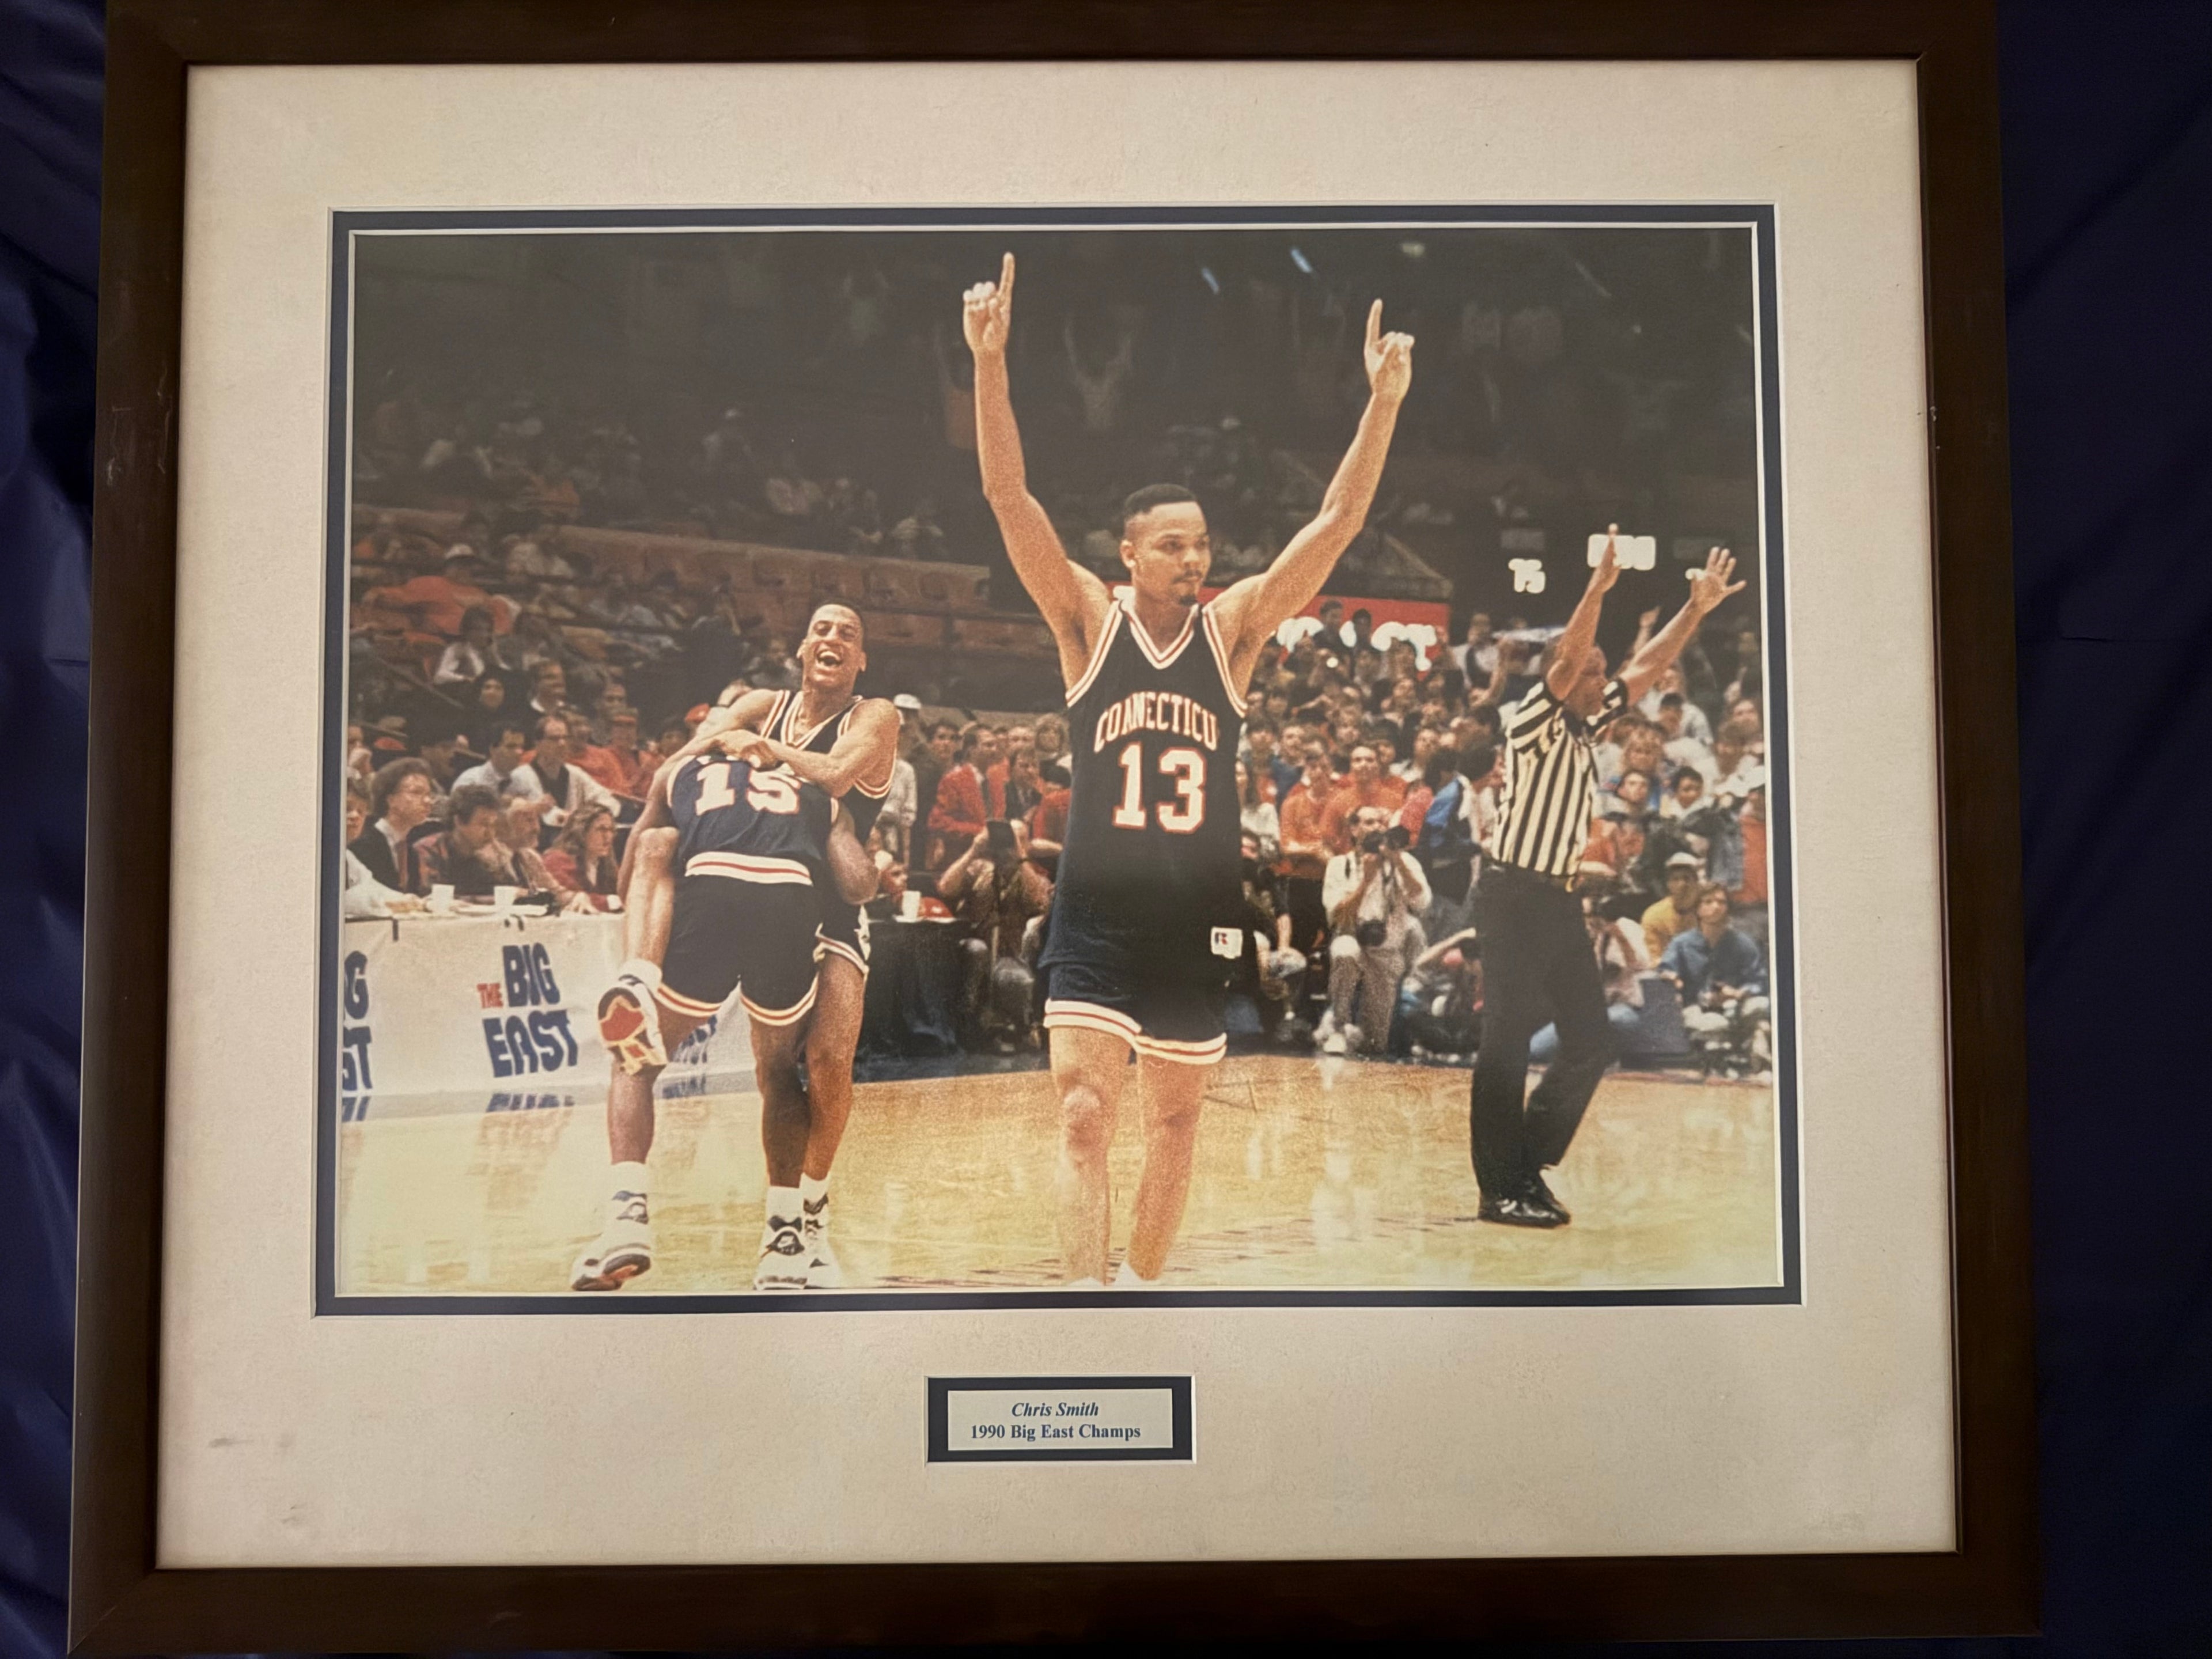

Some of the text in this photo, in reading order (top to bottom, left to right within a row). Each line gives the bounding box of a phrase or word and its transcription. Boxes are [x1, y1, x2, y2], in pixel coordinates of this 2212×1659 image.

[695, 762, 802, 815] 15
[1113, 741, 1206, 834] 13
[477, 943, 560, 1008] THE BIG
[483, 1009, 578, 1078] EAST
[971, 1424, 1141, 1441] 1990 Big East Champs
[1012, 1402, 1099, 1416] Chris Smith
